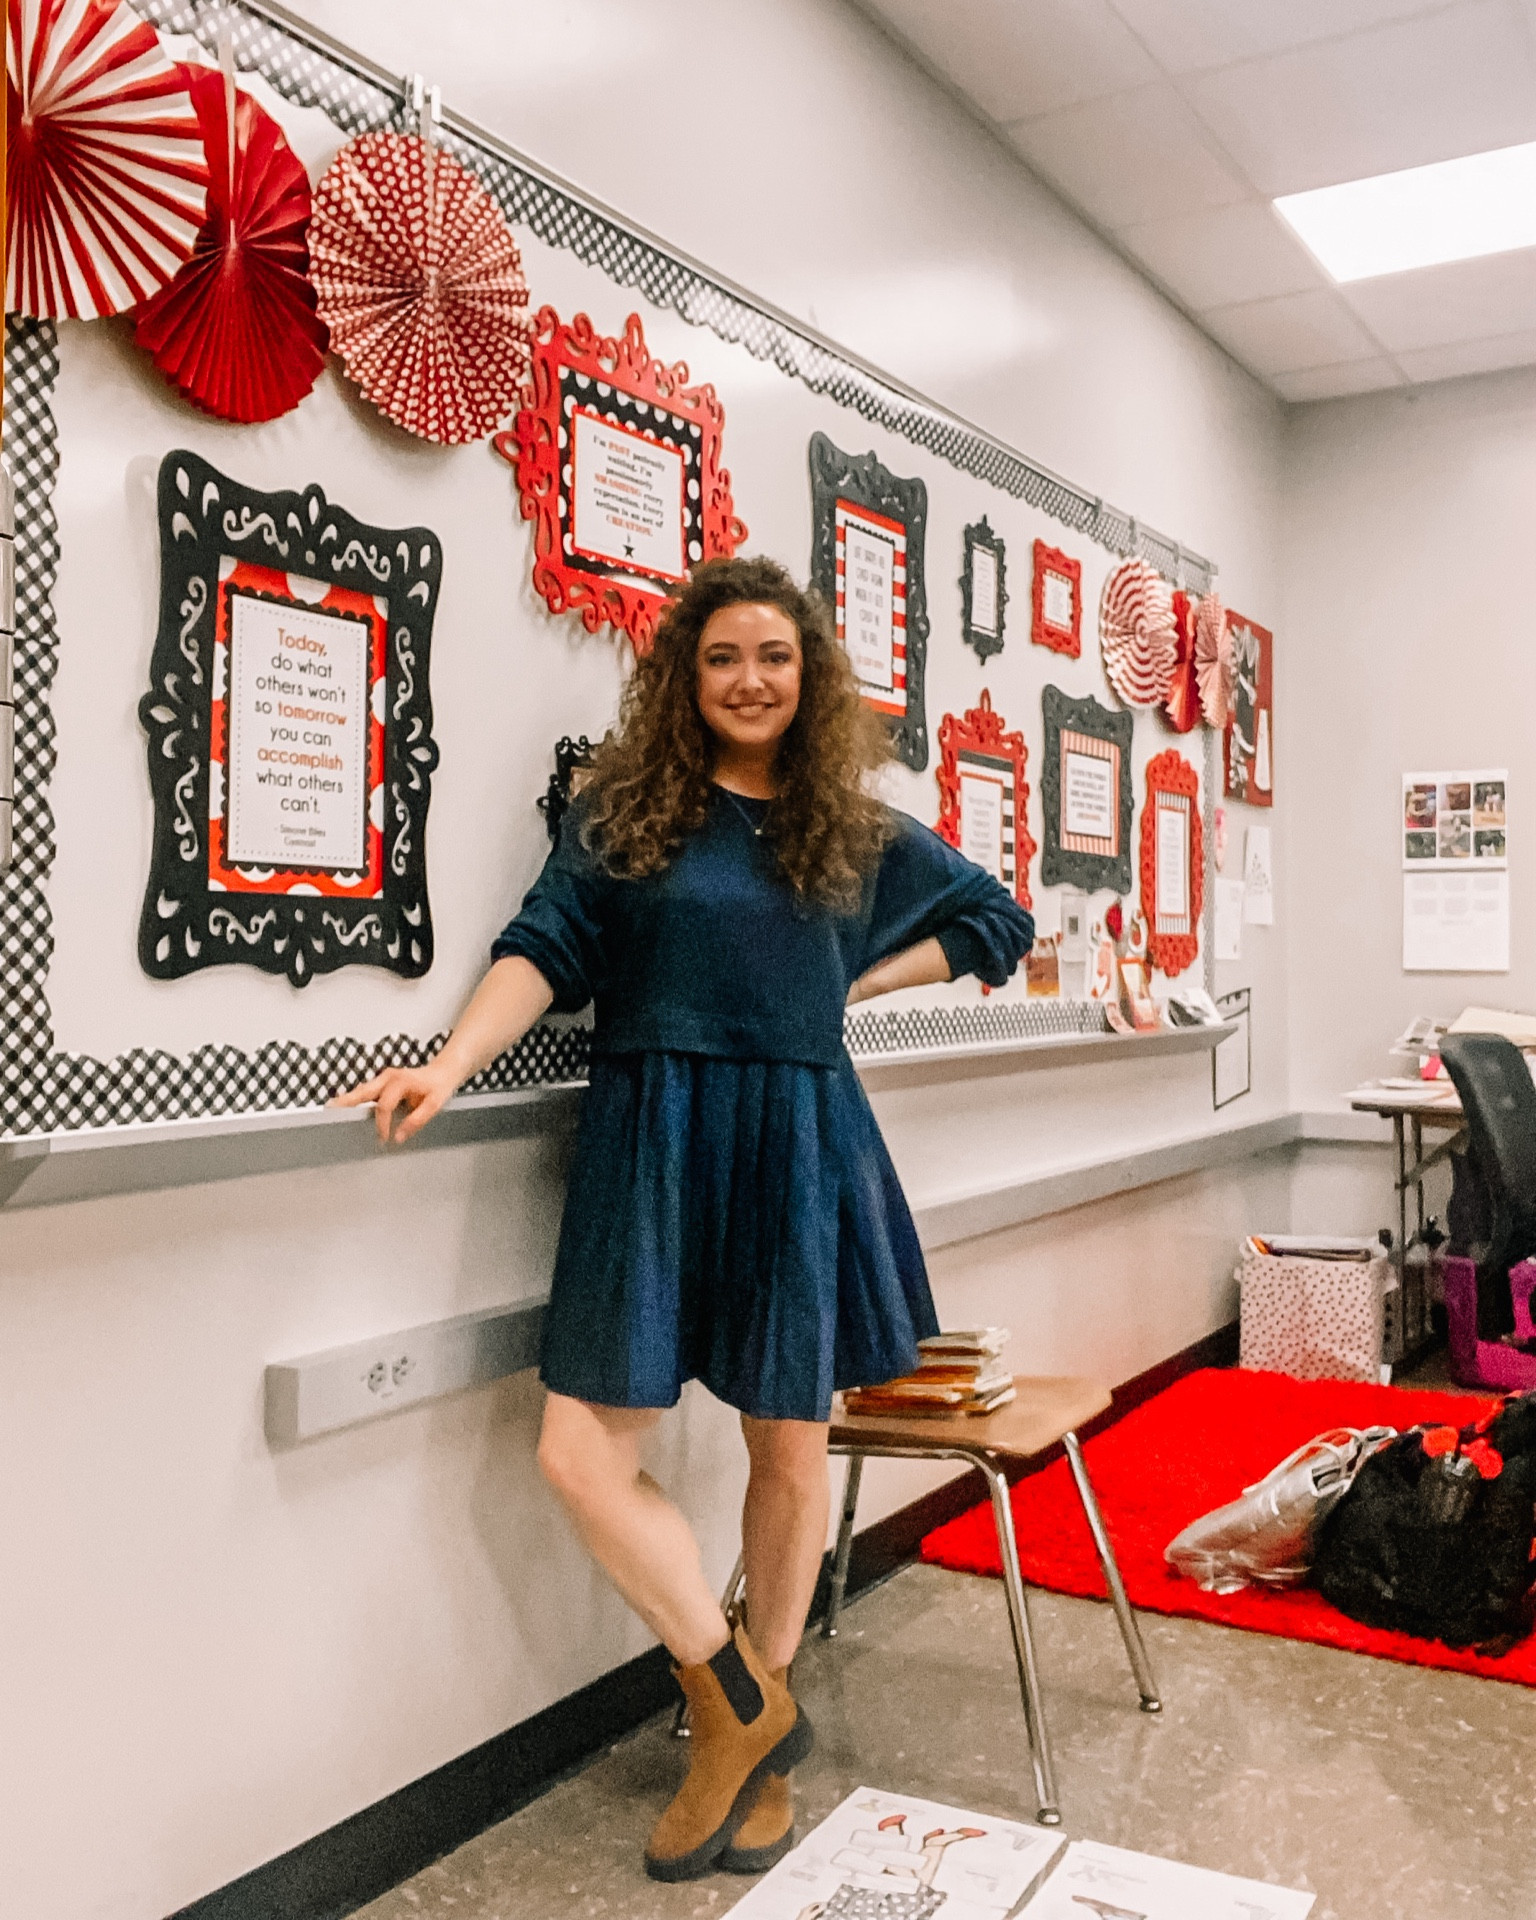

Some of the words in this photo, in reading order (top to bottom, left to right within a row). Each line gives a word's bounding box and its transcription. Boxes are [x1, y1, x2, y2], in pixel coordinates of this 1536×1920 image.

[277, 628, 328, 657] Today,
[271, 652, 293, 671] do
[297, 658, 333, 679] what
[255, 675, 303, 696] others
[308, 686, 346, 704] won't
[255, 700, 272, 714] so
[278, 701, 347, 725] tomorrow
[270, 727, 298, 742] you
[303, 731, 332, 746] can
[257, 748, 343, 771] accomplish
[256, 768, 293, 787] what
[298, 774, 343, 794] others
[280, 796, 321, 814] can't.
